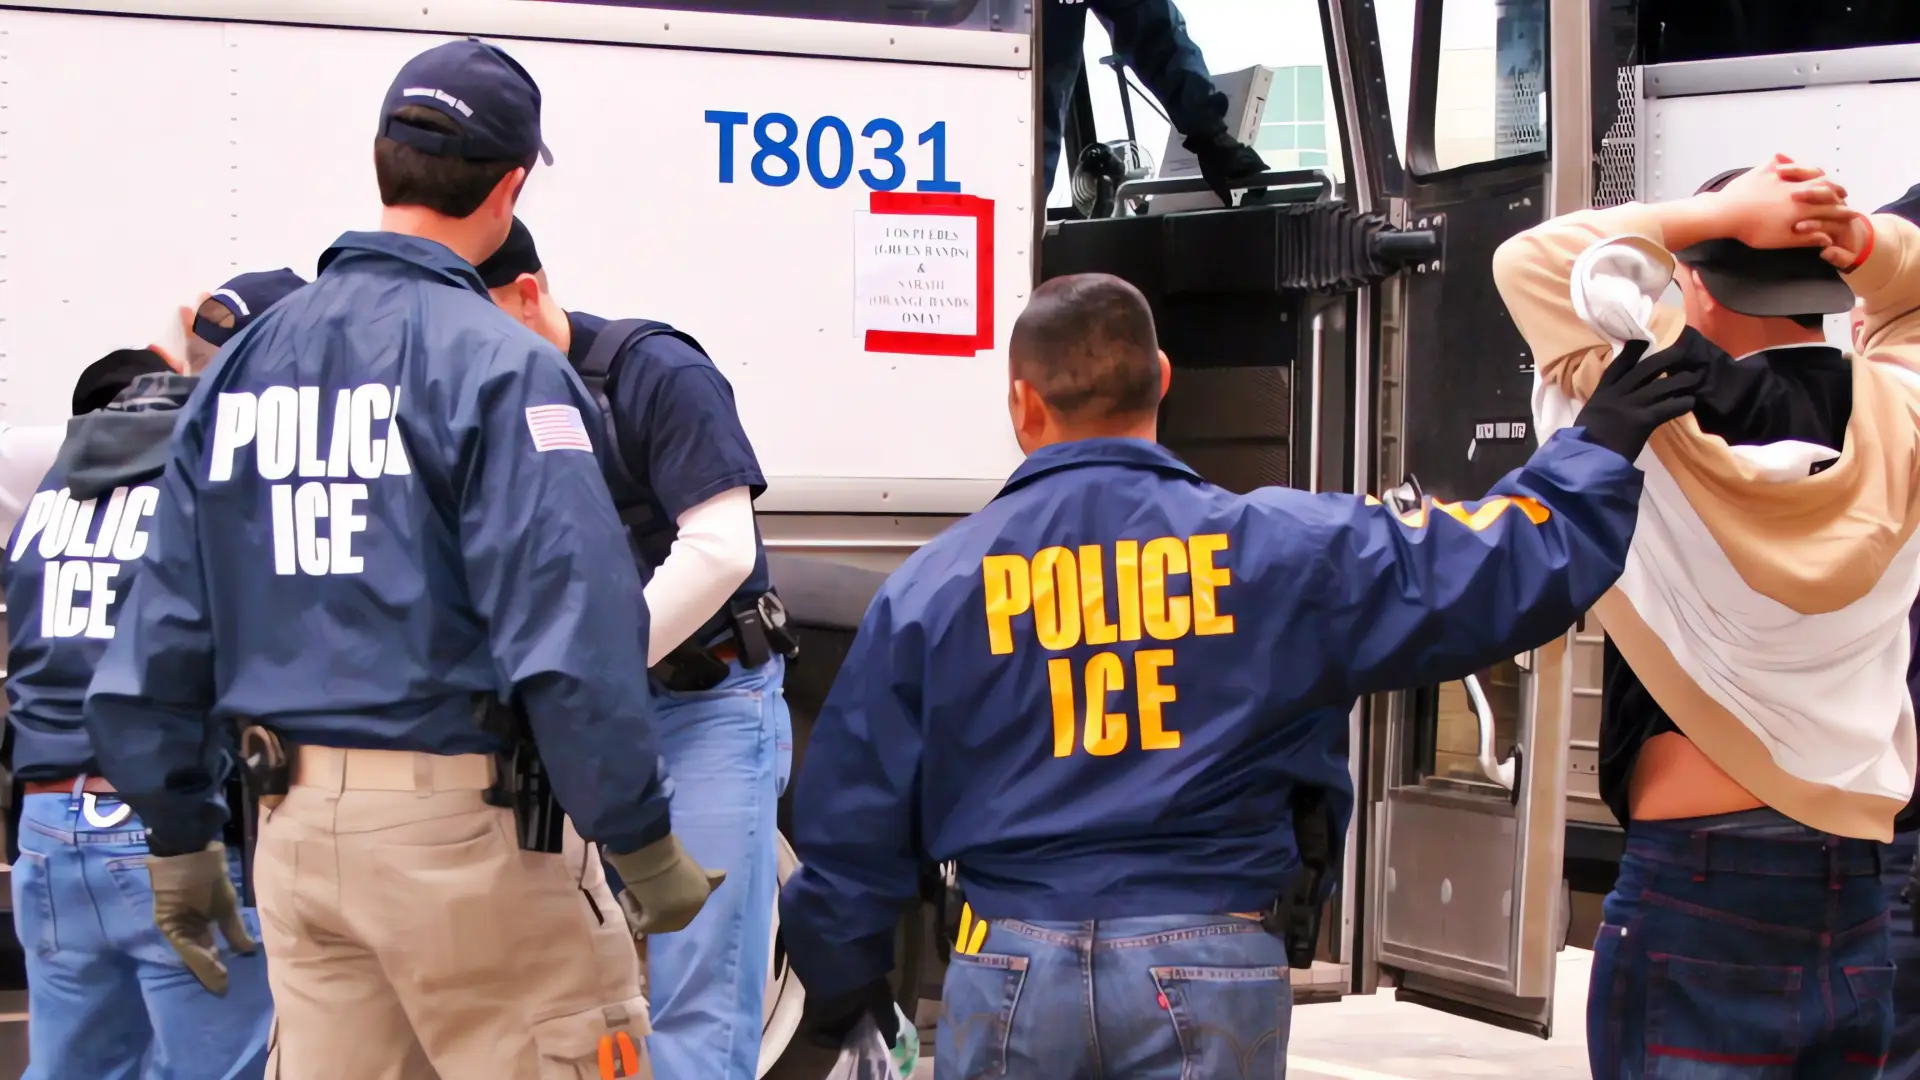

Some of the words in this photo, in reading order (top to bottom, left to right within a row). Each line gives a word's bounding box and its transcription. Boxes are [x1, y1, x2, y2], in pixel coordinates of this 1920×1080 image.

[705, 110, 961, 193] T8031
[917, 263, 926, 274] &
[271, 481, 368, 576] ICE
[41, 560, 121, 639] ICE
[983, 533, 1234, 655] POLICE
[1047, 649, 1181, 758] ICE
